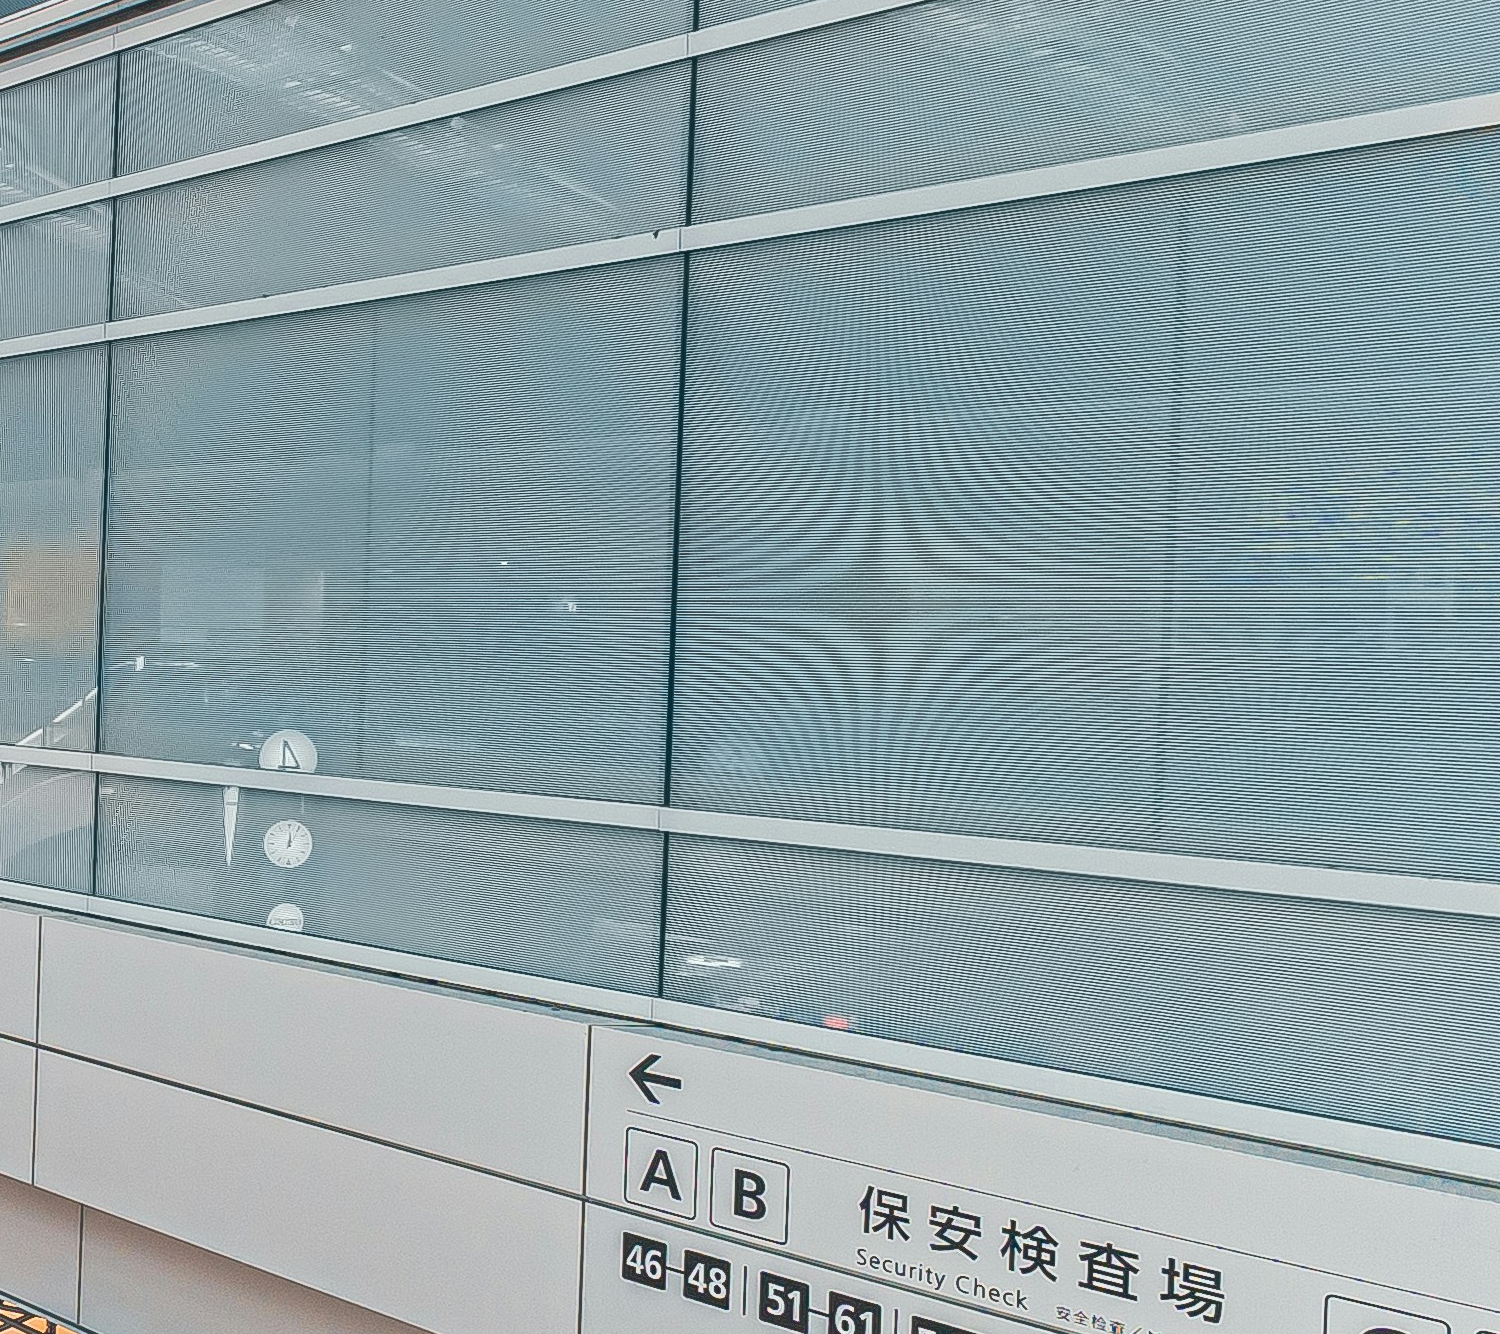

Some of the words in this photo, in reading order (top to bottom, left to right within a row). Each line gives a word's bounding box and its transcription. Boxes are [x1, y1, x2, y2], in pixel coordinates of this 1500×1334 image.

[640, 1149, 682, 1202] A
[733, 1168, 767, 1220] B
[859, 1185, 1225, 1325] 保安検査場
[626, 1244, 662, 1280] 46
[687, 1263, 728, 1300] 48
[766, 1282, 802, 1323] 51
[856, 1247, 946, 1289] Security
[956, 1274, 1030, 1312] Check
